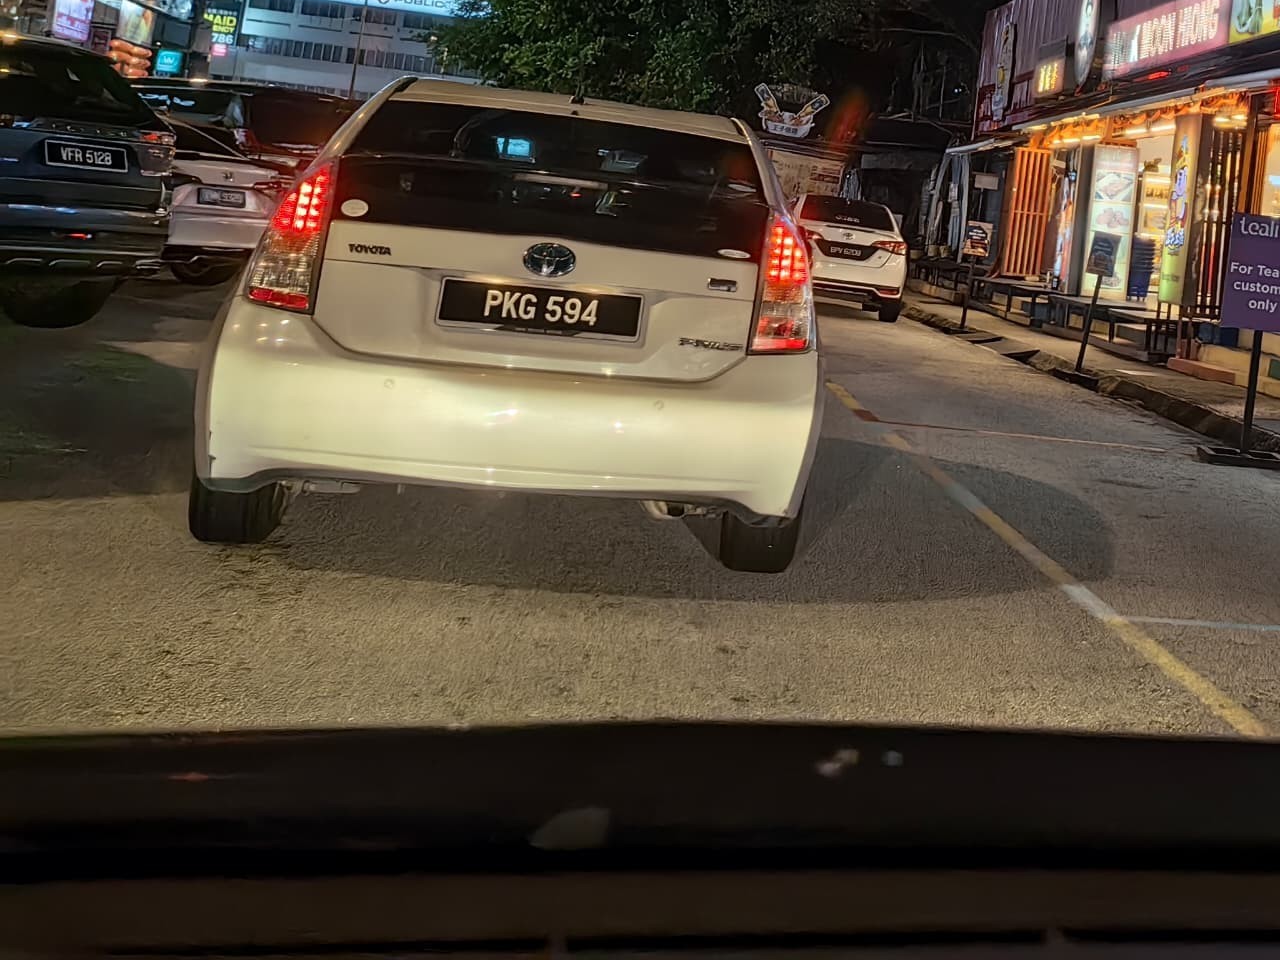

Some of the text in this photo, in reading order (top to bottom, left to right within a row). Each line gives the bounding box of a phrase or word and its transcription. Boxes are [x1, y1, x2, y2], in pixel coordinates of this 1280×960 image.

[212, 25, 235, 34] ENCY
[211, 32, 234, 45] 786
[61, 146, 113, 166] VFR 5128
[348, 243, 392, 257] TOYOTA
[1230, 261, 1254, 276] For
[483, 289, 599, 327] PKG 594
[1248, 299, 1278, 313] only
